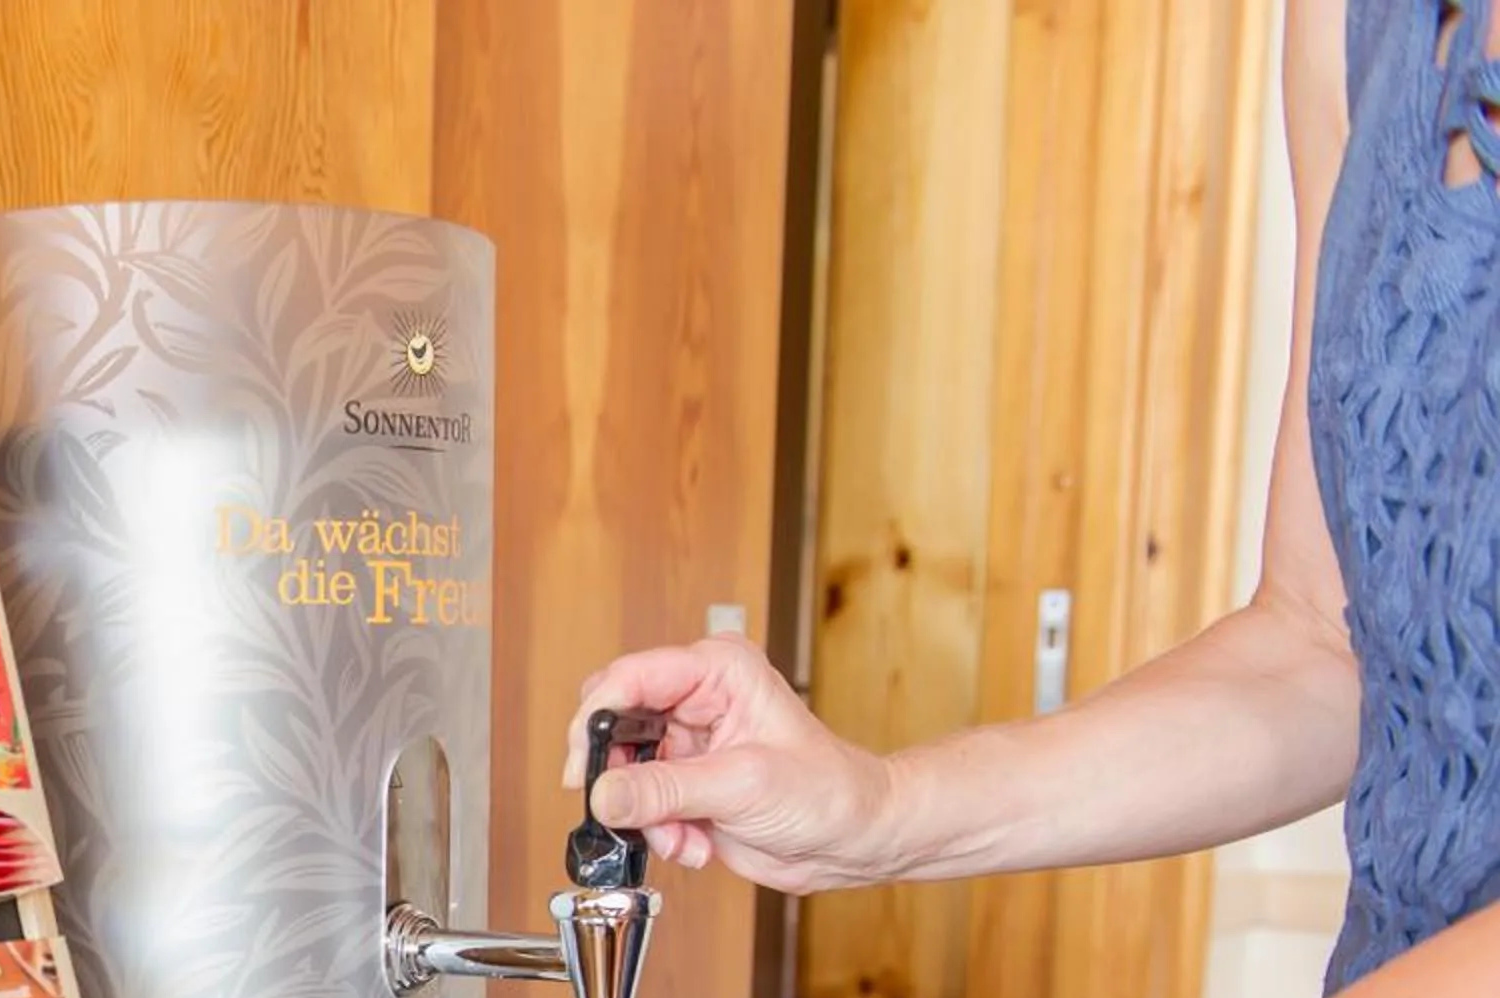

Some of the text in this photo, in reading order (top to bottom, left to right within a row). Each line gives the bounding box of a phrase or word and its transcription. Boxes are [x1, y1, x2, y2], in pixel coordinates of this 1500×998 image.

[344, 400, 471, 444] SONNENTOR
[214, 505, 461, 558] Da wächst
[278, 557, 357, 606] die
